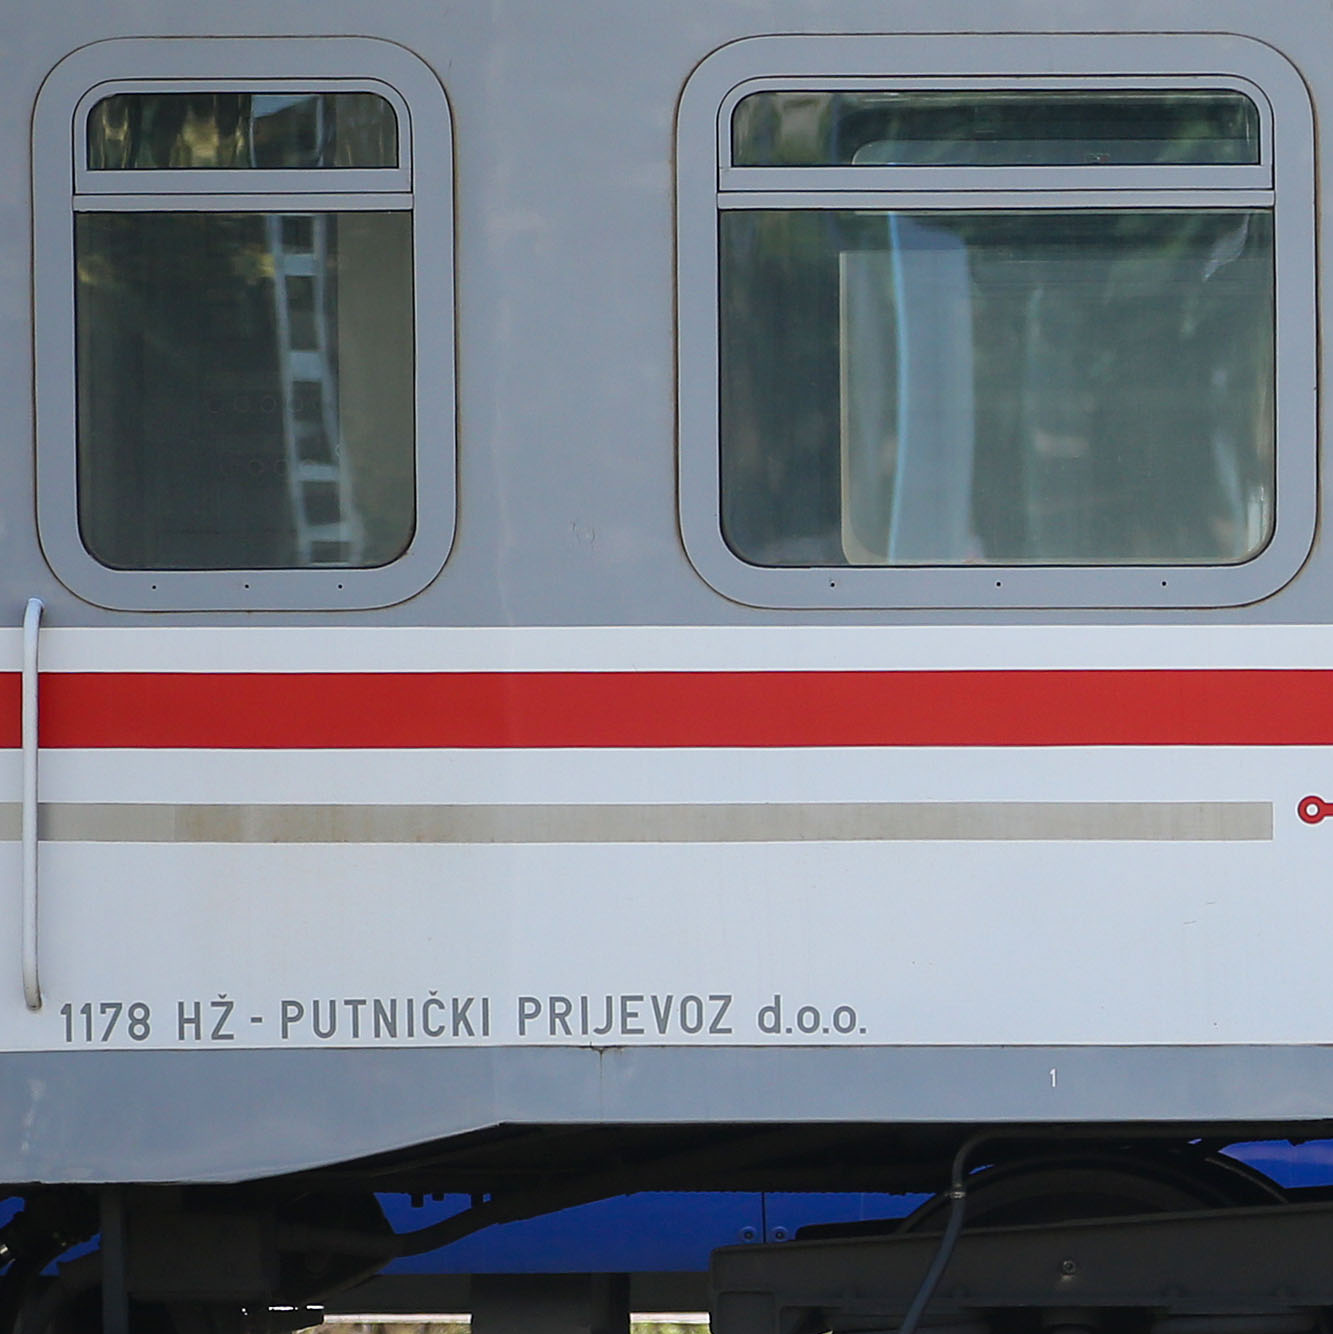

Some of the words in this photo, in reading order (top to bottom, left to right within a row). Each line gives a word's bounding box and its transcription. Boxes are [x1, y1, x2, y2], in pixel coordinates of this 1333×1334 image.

[60, 1002, 152, 1042] 1178
[177, 994, 235, 1041] HŽ
[281, 991, 490, 1039] PUTNIČKI
[518, 994, 734, 1037] PRIJEVOZ
[757, 995, 868, 1035] d.o.o.
[1049, 1068, 1058, 1087] 1
